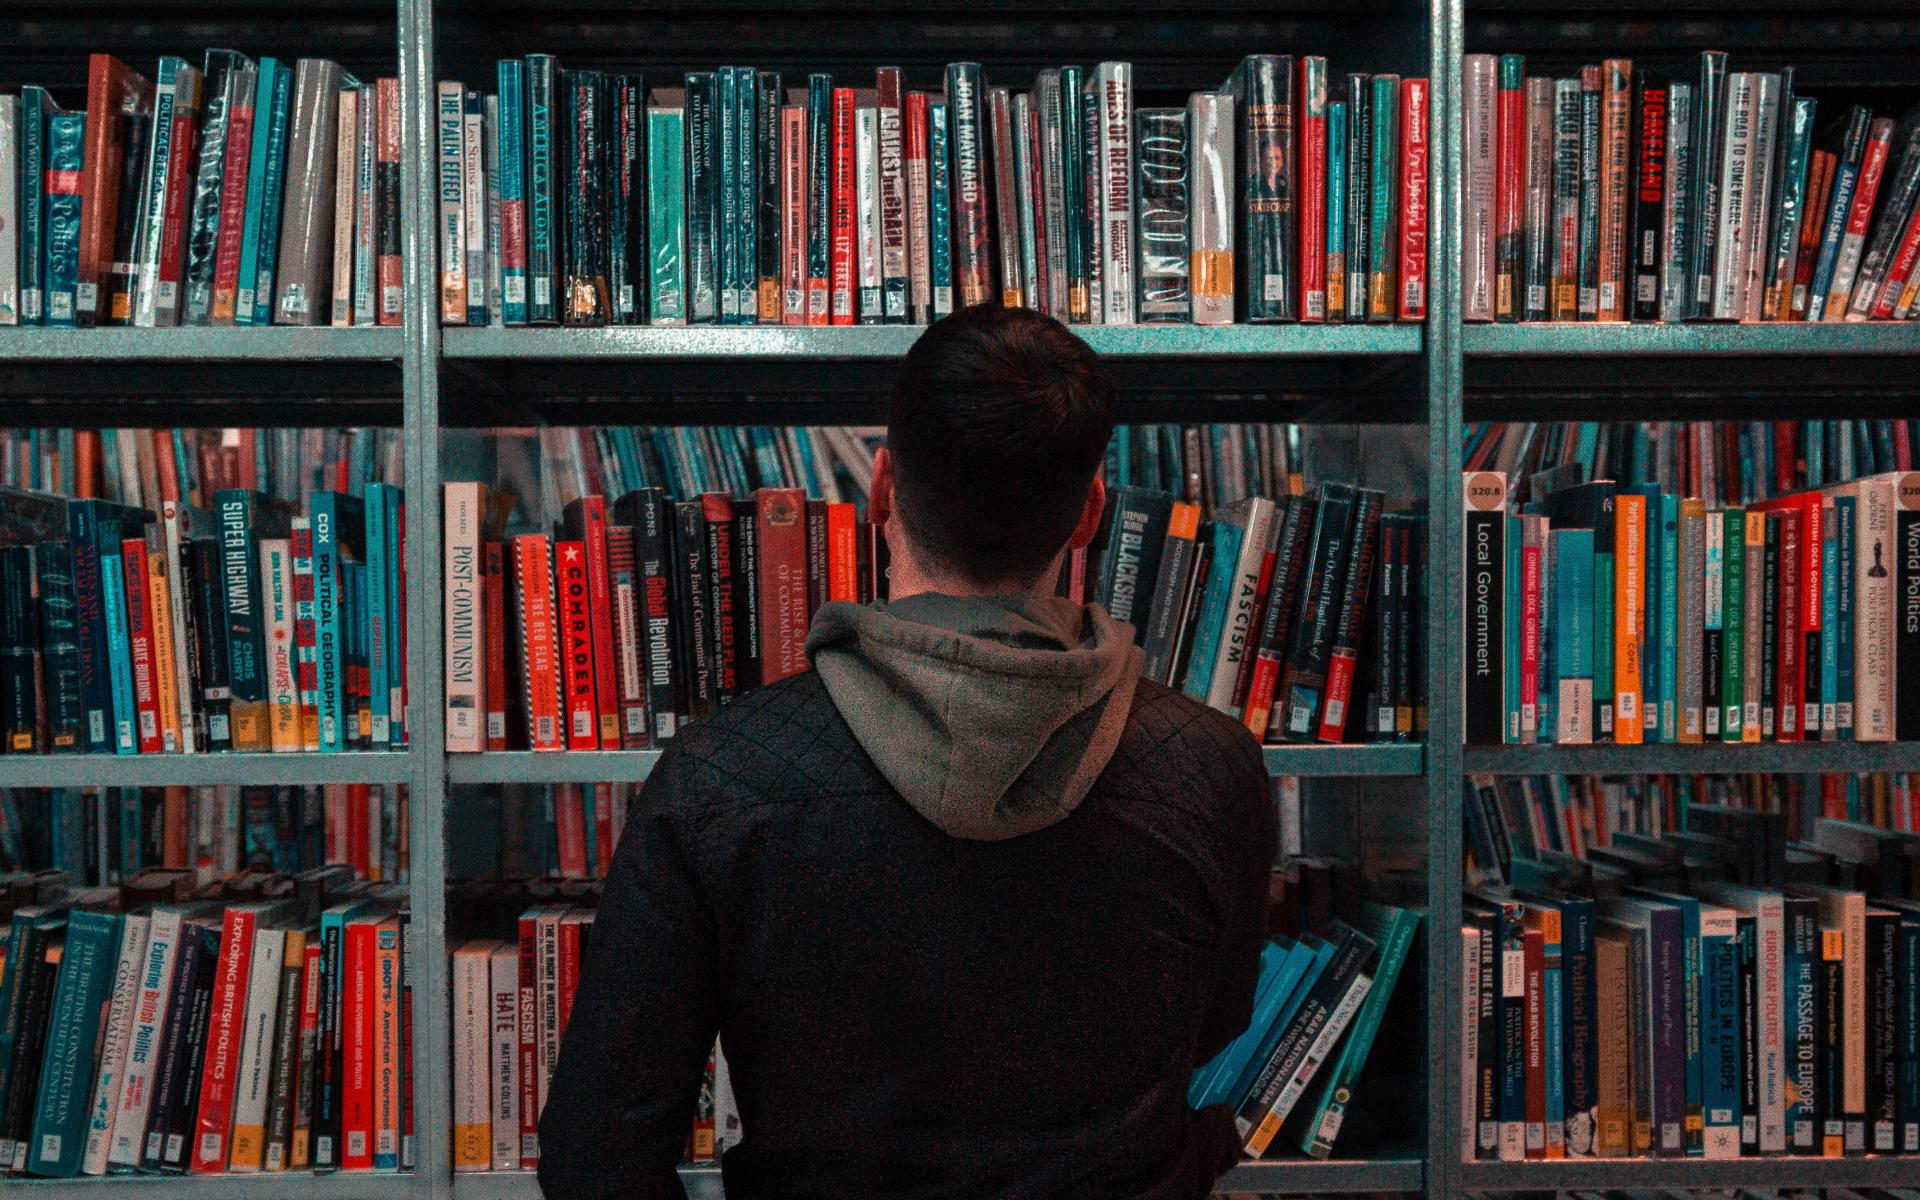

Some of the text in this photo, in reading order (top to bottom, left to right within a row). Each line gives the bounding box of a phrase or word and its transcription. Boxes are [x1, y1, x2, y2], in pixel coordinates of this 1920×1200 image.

[156, 94, 172, 152] POLITICAL
[443, 93, 460, 204] THE PALIN EFFECT
[468, 123, 478, 185] Leo Strauss
[769, 140, 776, 150] OF
[881, 108, 901, 177] AGAINST
[957, 78, 977, 202] JOAN MAYNARD
[1107, 81, 1129, 212] AGES OF REFORM
[1640, 89, 1664, 203] HOMELAND
[1729, 87, 1750, 225] THE ROAD TO SOMEWHERE
[534, 104, 548, 252] AMERICA ALONE
[884, 197, 903, 248] GRAIN
[1675, 146, 1687, 268] SAVING THE PEOPLE
[1828, 170, 1853, 243] ANARCHISM
[52, 203, 73, 273] Politics
[1112, 220, 1120, 261] MORGAN
[223, 502, 250, 616] SUPER HIGHWAY
[645, 503, 655, 536] PONS
[710, 533, 718, 569] HISTORY
[1266, 505, 1300, 639] THE RISE OF THE FAR RIGHT
[318, 513, 334, 718] COX POLITICAL GEOGRAPHY
[453, 546, 472, 683] POST-COMMUNISM
[644, 560, 670, 685] The Global Revolution
[689, 551, 708, 699] The End of Communist Power
[712, 572, 718, 583] OF
[713, 585, 721, 640] COMMUNISM
[718, 525, 736, 689] UNDER THE RED FLAG
[778, 565, 791, 673] OF COMMUNISM
[794, 569, 805, 670] THE RISE & FALL
[1228, 574, 1256, 663] FASCISM
[1478, 523, 1491, 675] Local Government
[1527, 552, 1536, 660] COMPARING LOCAL GOVERNANCE
[1730, 518, 1740, 678] THE NATURE OF BRITISH LOCAL GOVERNMENT
[1810, 571, 1818, 626] GOVERNMENT
[1907, 523, 1920, 633] World Politics
[133, 637, 150, 702] STATE BUILDING
[232, 640, 244, 682] PARRY
[243, 642, 254, 679] CHRIS
[532, 598, 547, 671] THE RED FLAG
[569, 567, 589, 695] COMRADES
[715, 643, 722, 652] IN
[715, 654, 723, 688] BRITAIN
[103, 960, 129, 1066] CONSERVATISM
[133, 942, 168, 1063] Exploring British Politics
[214, 917, 243, 1079] EXPLORING BRITISH POLITICS
[383, 959, 392, 1064] IDIOT'S American
[522, 988, 534, 1044] FASCISM
[546, 957, 555, 980] RIGHT
[547, 983, 554, 991] IN
[1306, 1006, 1326, 1034] ARAB
[1482, 929, 1492, 1017] AFTER THE FALL
[1718, 944, 1734, 1092] POLITICS IN EUROPE
[1766, 930, 1777, 1047] EUROPEAN POLITICS
[44, 942, 81, 1120] IN THE TWENTIETH CENTURY
[56, 944, 95, 1125] THE BRITISH CONSTITUTION
[496, 993, 514, 1120] HATE MATTHEW COLLINS
[1261, 1036, 1309, 1104] NATIONALISM
[1797, 963, 1813, 1114] THE PASSAGE TO EUROPE
